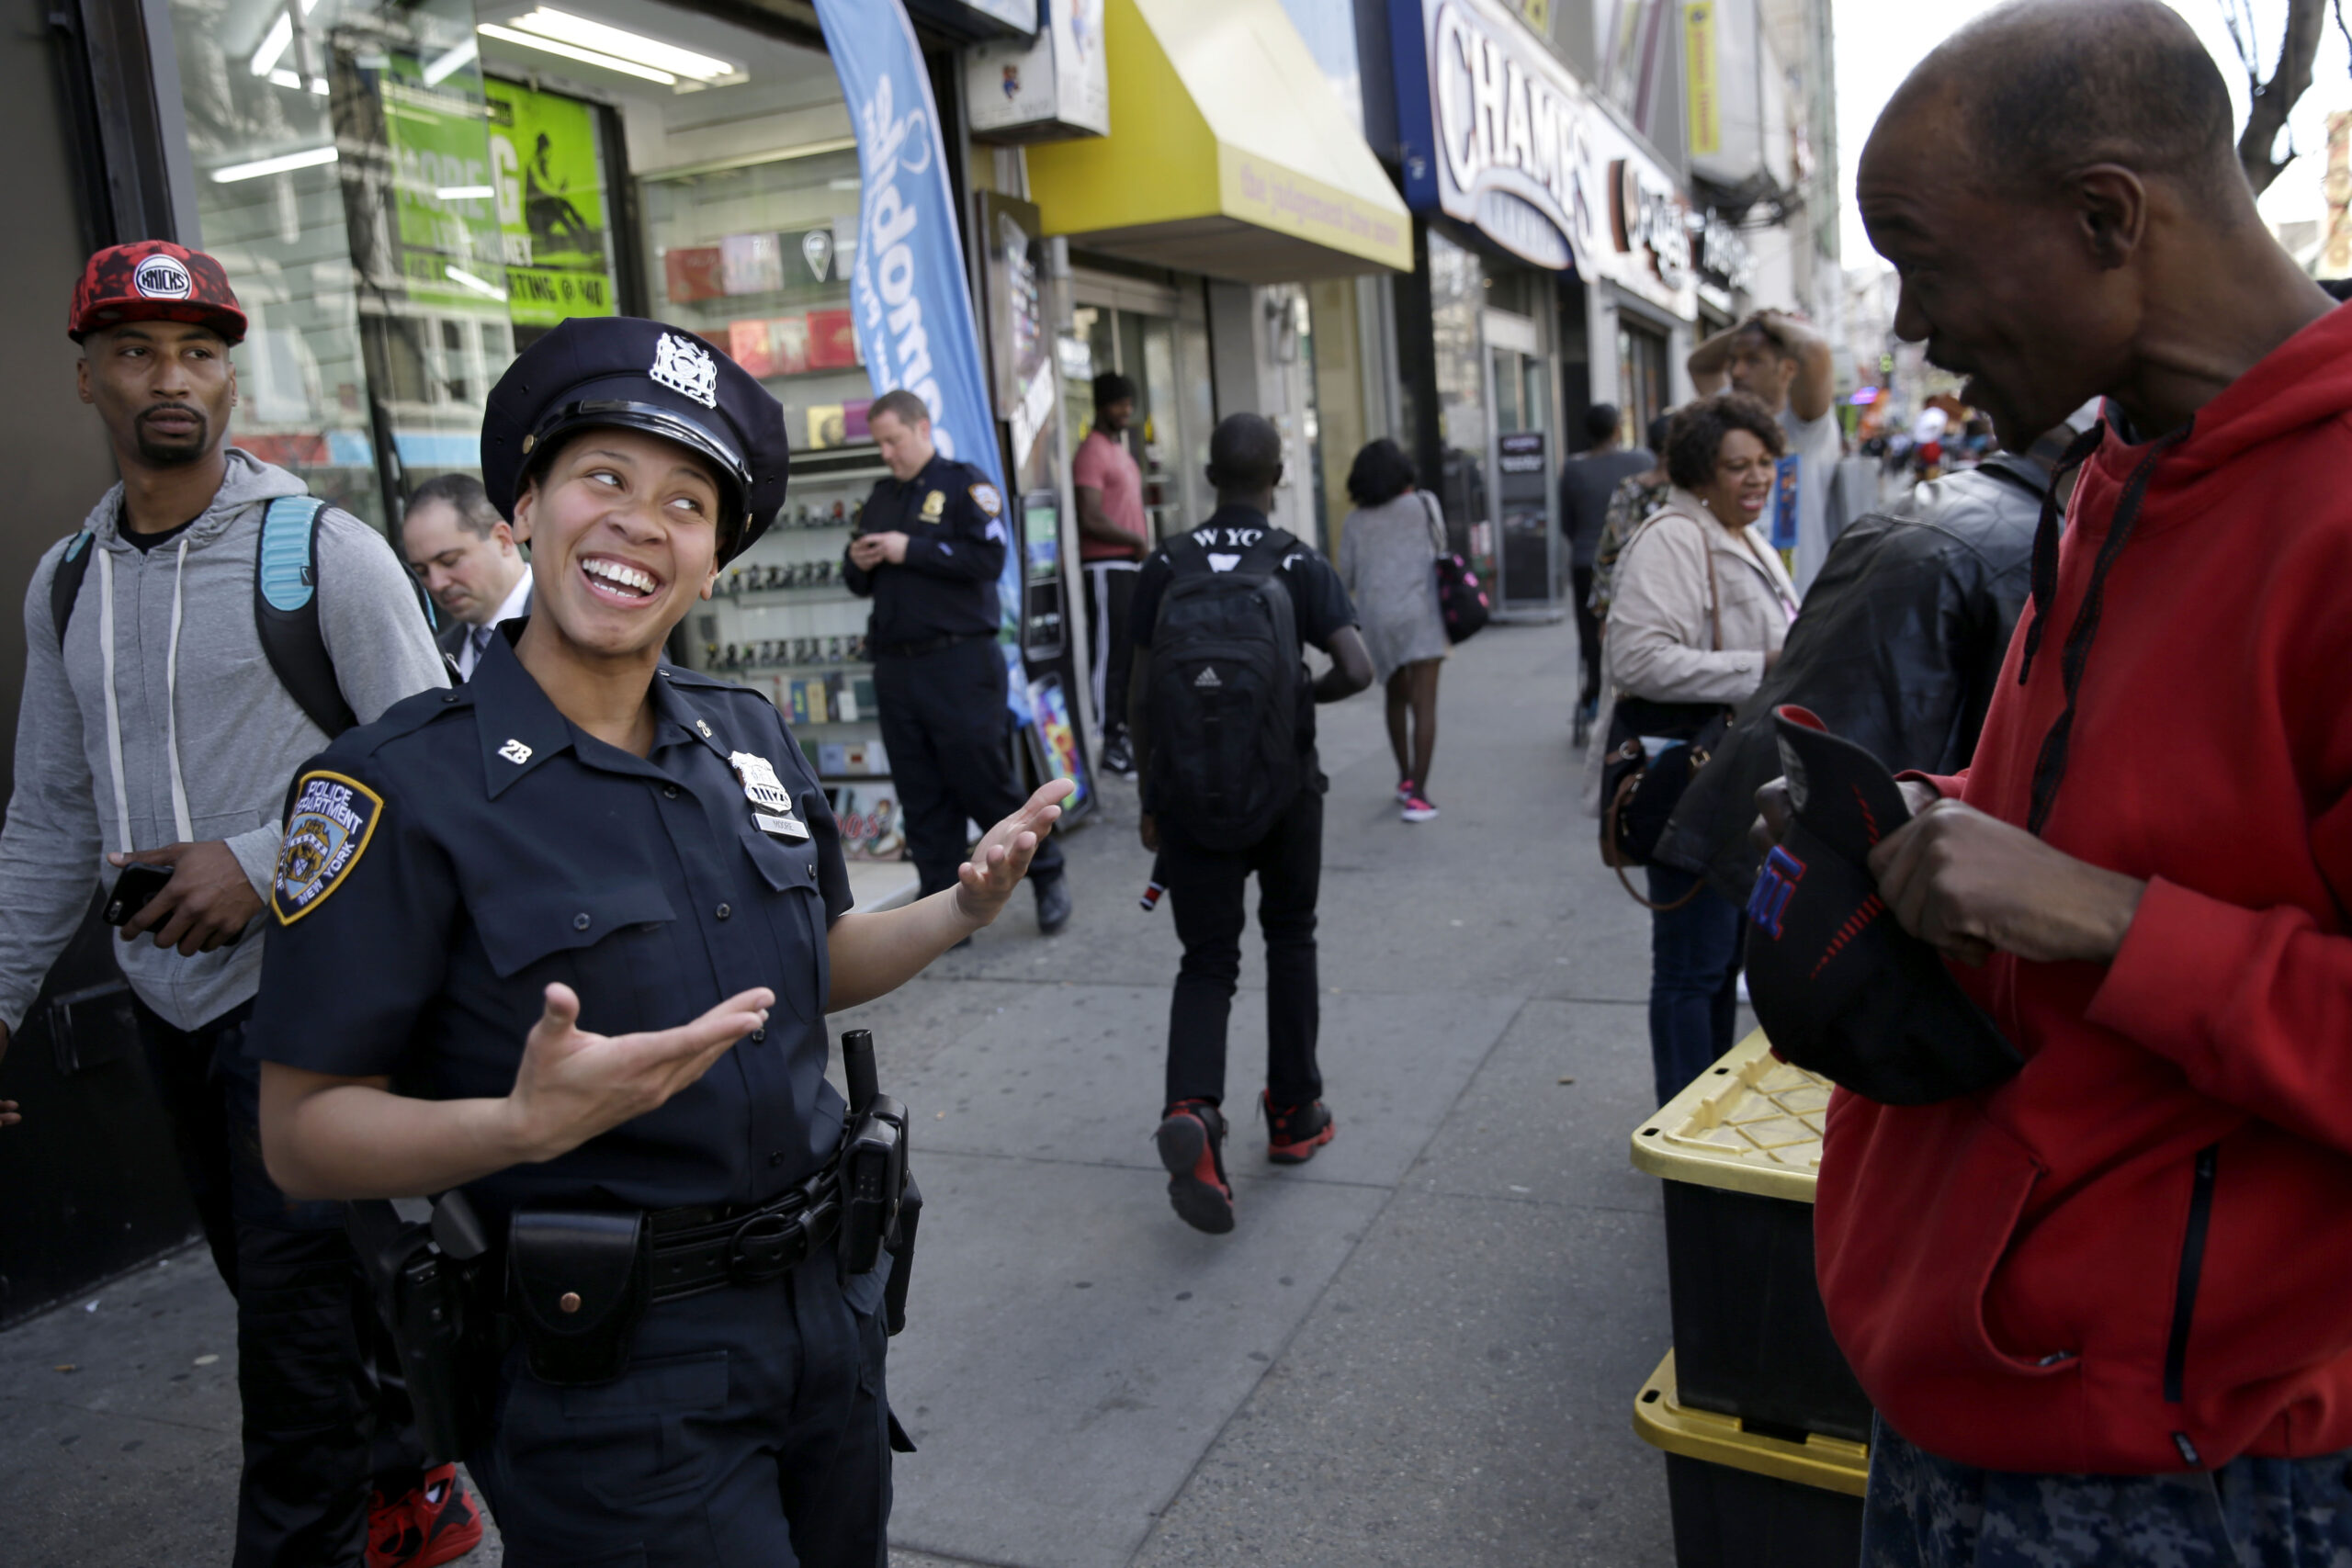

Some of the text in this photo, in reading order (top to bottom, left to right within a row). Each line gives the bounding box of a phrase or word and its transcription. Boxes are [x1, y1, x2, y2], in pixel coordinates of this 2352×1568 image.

[1436, 2, 1595, 259] CHAMPS
[492, 134, 522, 226] G
[141, 268, 186, 290] KNICKS
[306, 780, 354, 807] POLICE
[298, 840, 356, 906] NEW YORK
